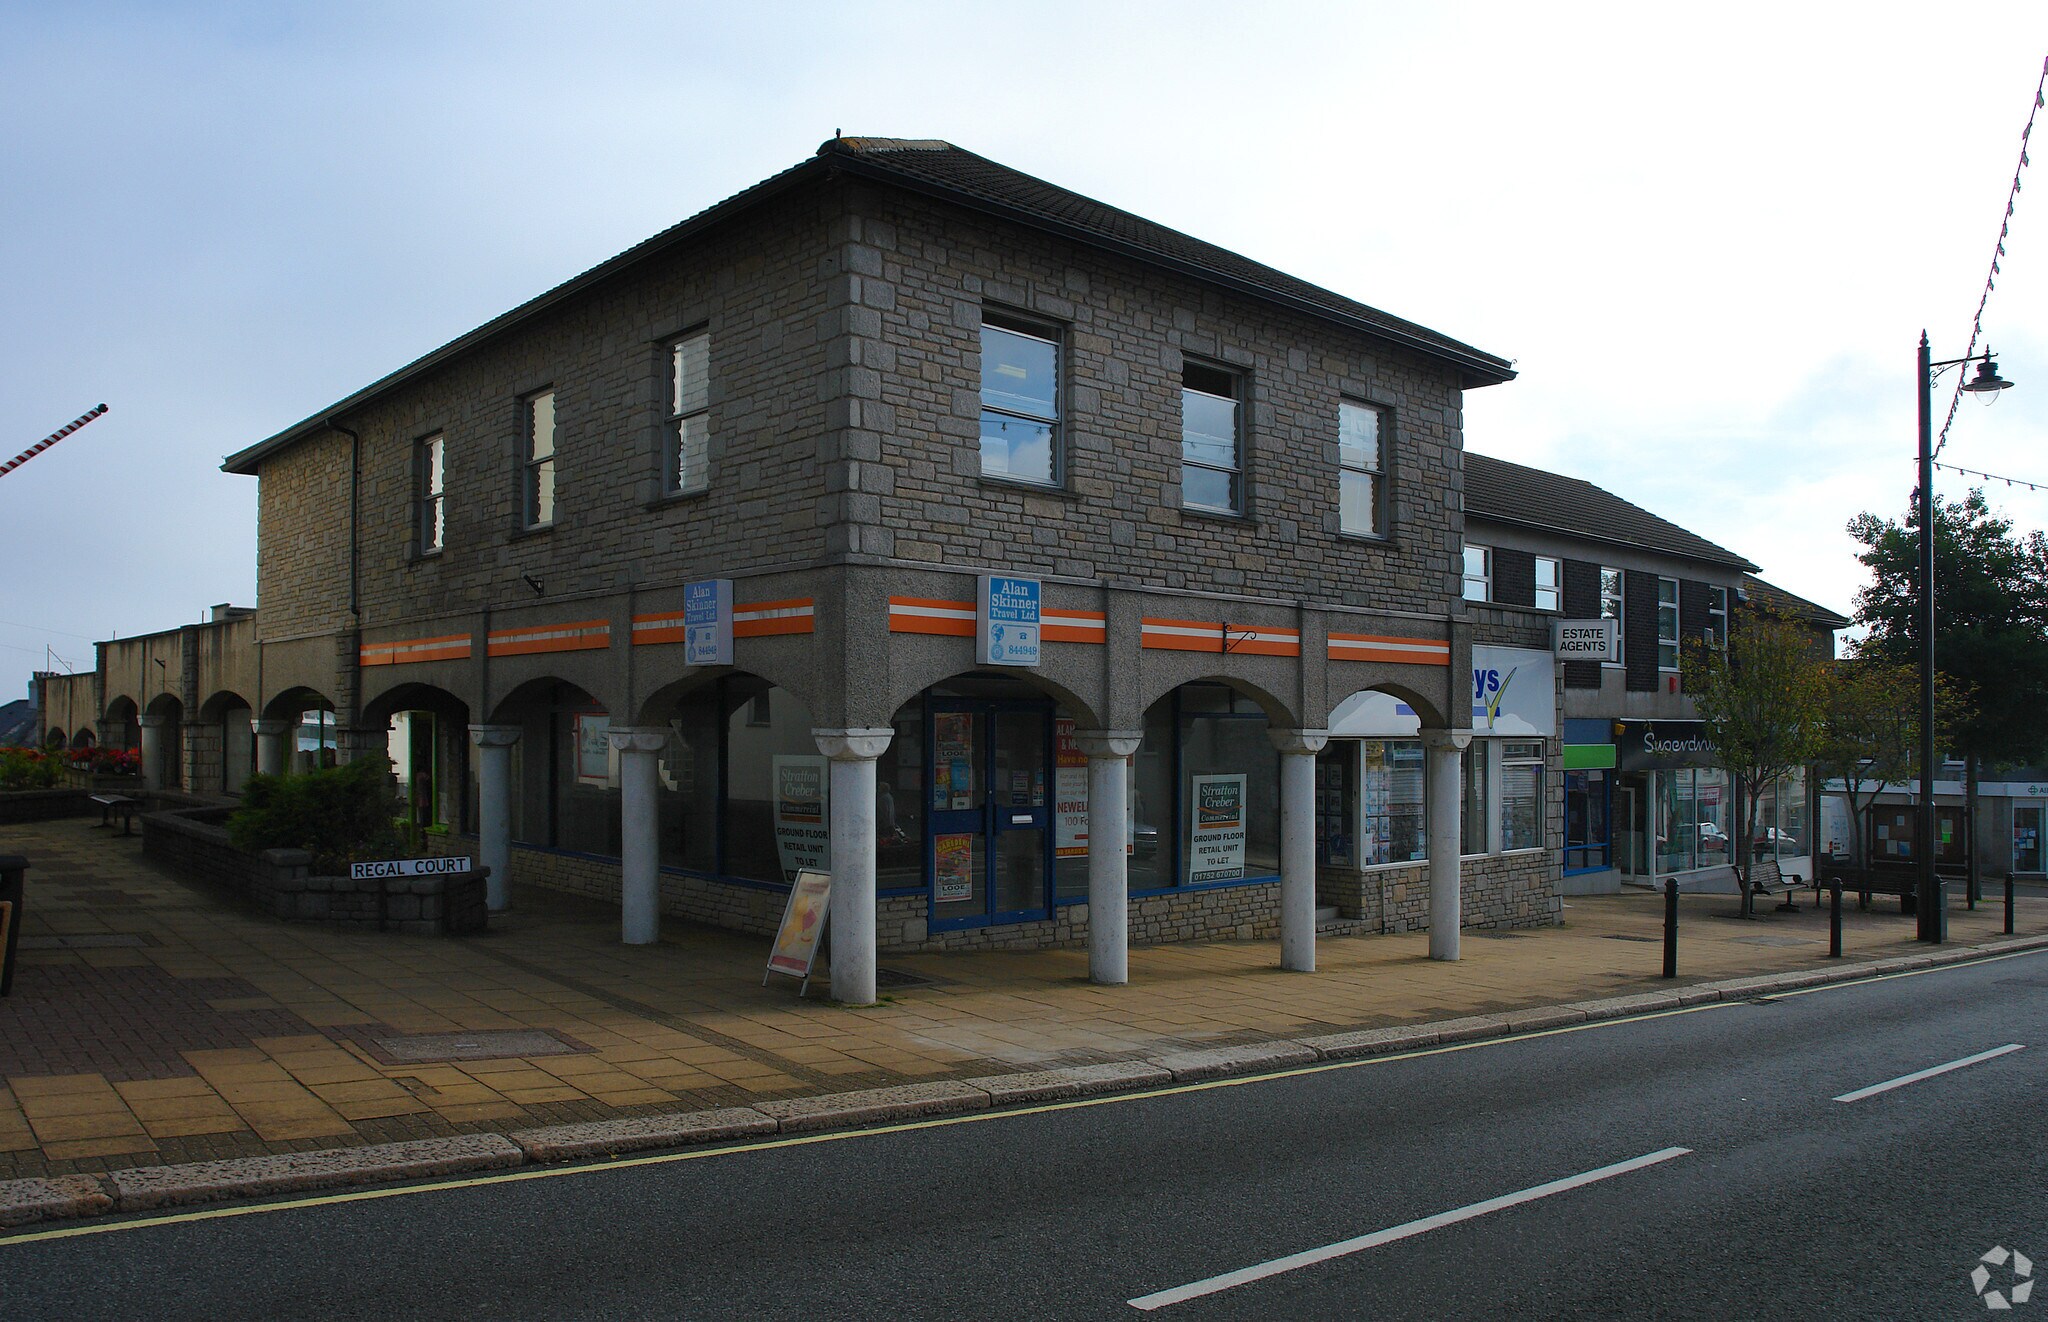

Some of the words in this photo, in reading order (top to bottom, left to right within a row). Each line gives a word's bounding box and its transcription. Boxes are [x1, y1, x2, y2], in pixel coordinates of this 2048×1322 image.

[692, 586, 711, 599] Alan
[1001, 580, 1028, 596] Alan
[686, 599, 717, 612] Skinner
[991, 593, 1038, 610] Skinner
[686, 613, 704, 623] Travel
[991, 607, 1018, 619] Travel
[1562, 628, 1604, 639] ESTATE
[1008, 644, 1038, 656] 844949
[1559, 641, 1606, 652] AGENTS
[1472, 669, 1500, 698] ys
[1057, 755, 1077, 765] Have
[782, 768, 819, 782] Stratton
[784, 782, 816, 797] Creber
[1202, 784, 1239, 797] Stratton
[1205, 796, 1235, 808] Creber
[781, 803, 819, 814] Commercial
[1065, 816, 1078, 826] 100
[1201, 812, 1238, 822] Commercial
[777, 827, 804, 837] GROUND
[806, 829, 828, 839] FLOOR
[1194, 834, 1222, 843] GROUND
[1223, 832, 1244, 841] FLOOR
[784, 841, 806, 852] RETAIL
[808, 845, 824, 853] UNIT
[1198, 846, 1222, 855] RETAIL
[1223, 844, 1239, 852] UNIT
[795, 857, 804, 865] TO
[805, 859, 818, 867] LET
[1207, 858, 1216, 866] TO
[1217, 857, 1230, 865] LET
[354, 862, 406, 878] REGAL
[415, 858, 466, 874] COURT
[1194, 872, 1215, 880] 01752
[1216, 869, 1240, 878] 670700
